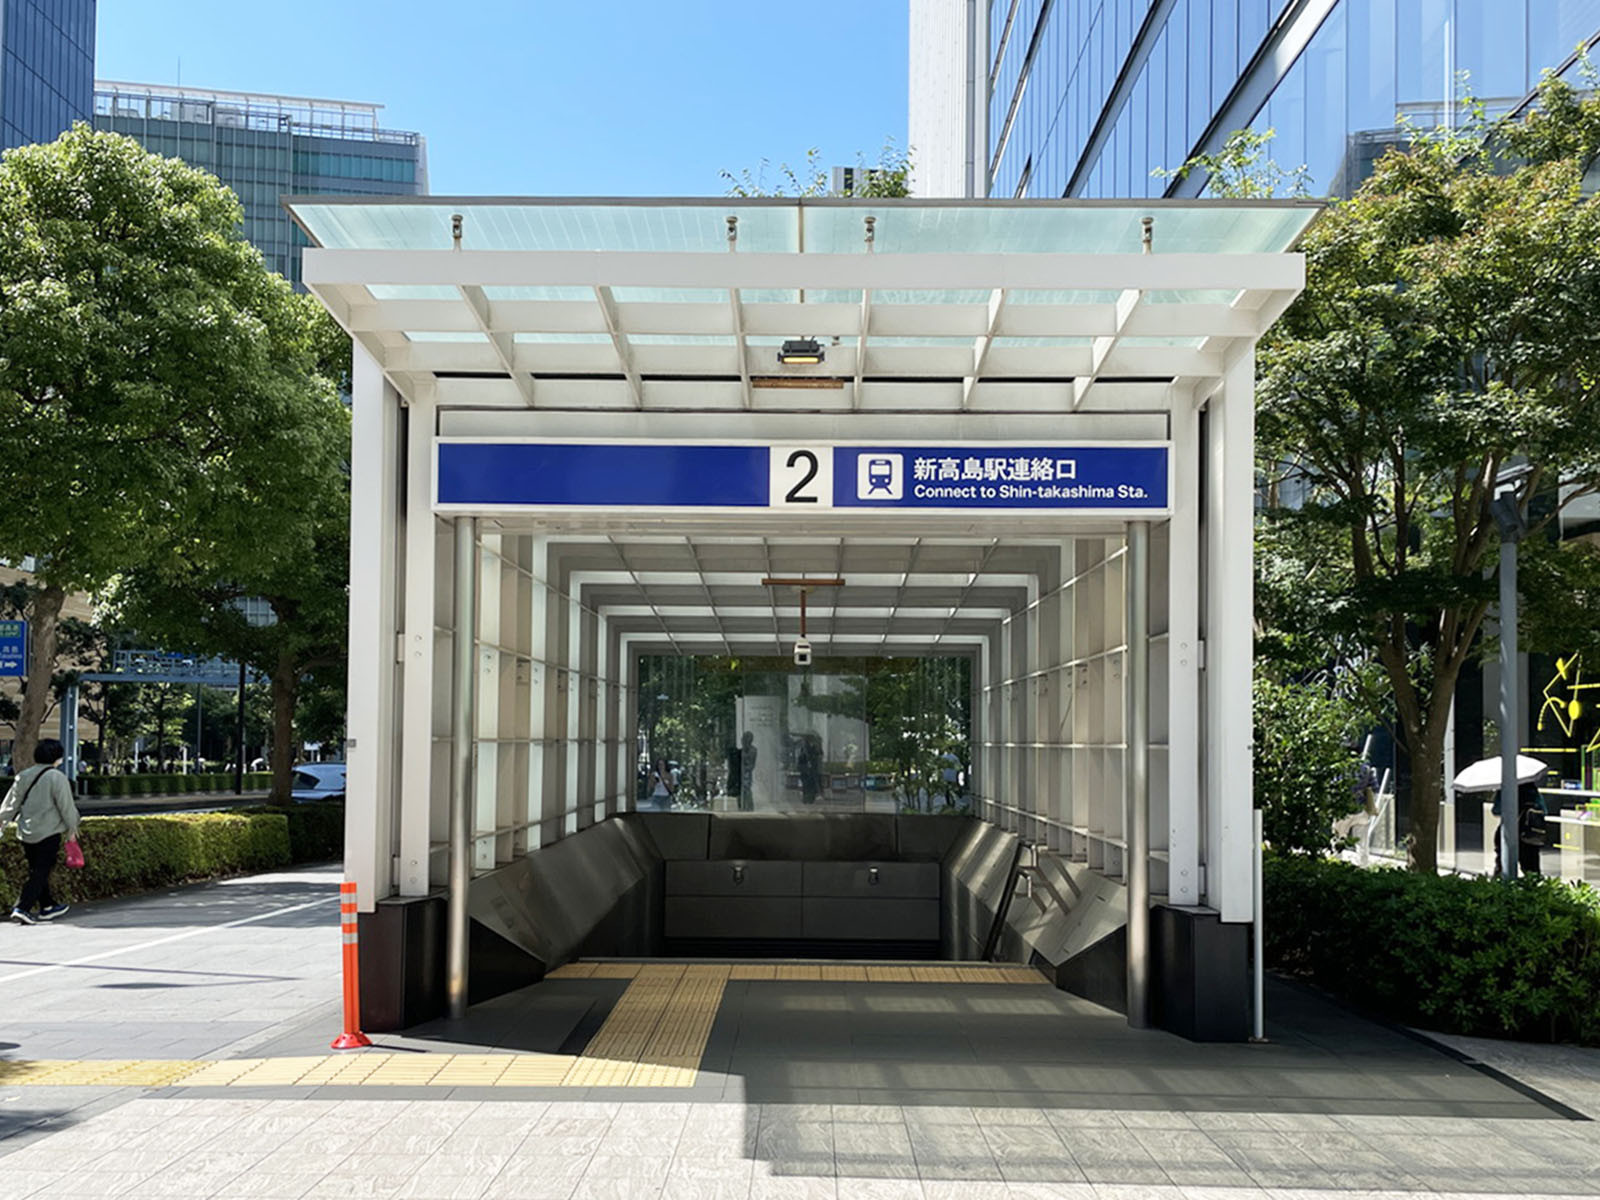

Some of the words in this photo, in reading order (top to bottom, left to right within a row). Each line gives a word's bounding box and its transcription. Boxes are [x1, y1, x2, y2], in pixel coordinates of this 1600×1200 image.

[785, 449, 819, 503] 2
[913, 456, 1076, 481] 新高島駅連絡口
[914, 484, 977, 499] Connect
[980, 485, 997, 499] to
[999, 484, 1115, 499] Shin-takashima
[1117, 484, 1148, 499] Sta.
